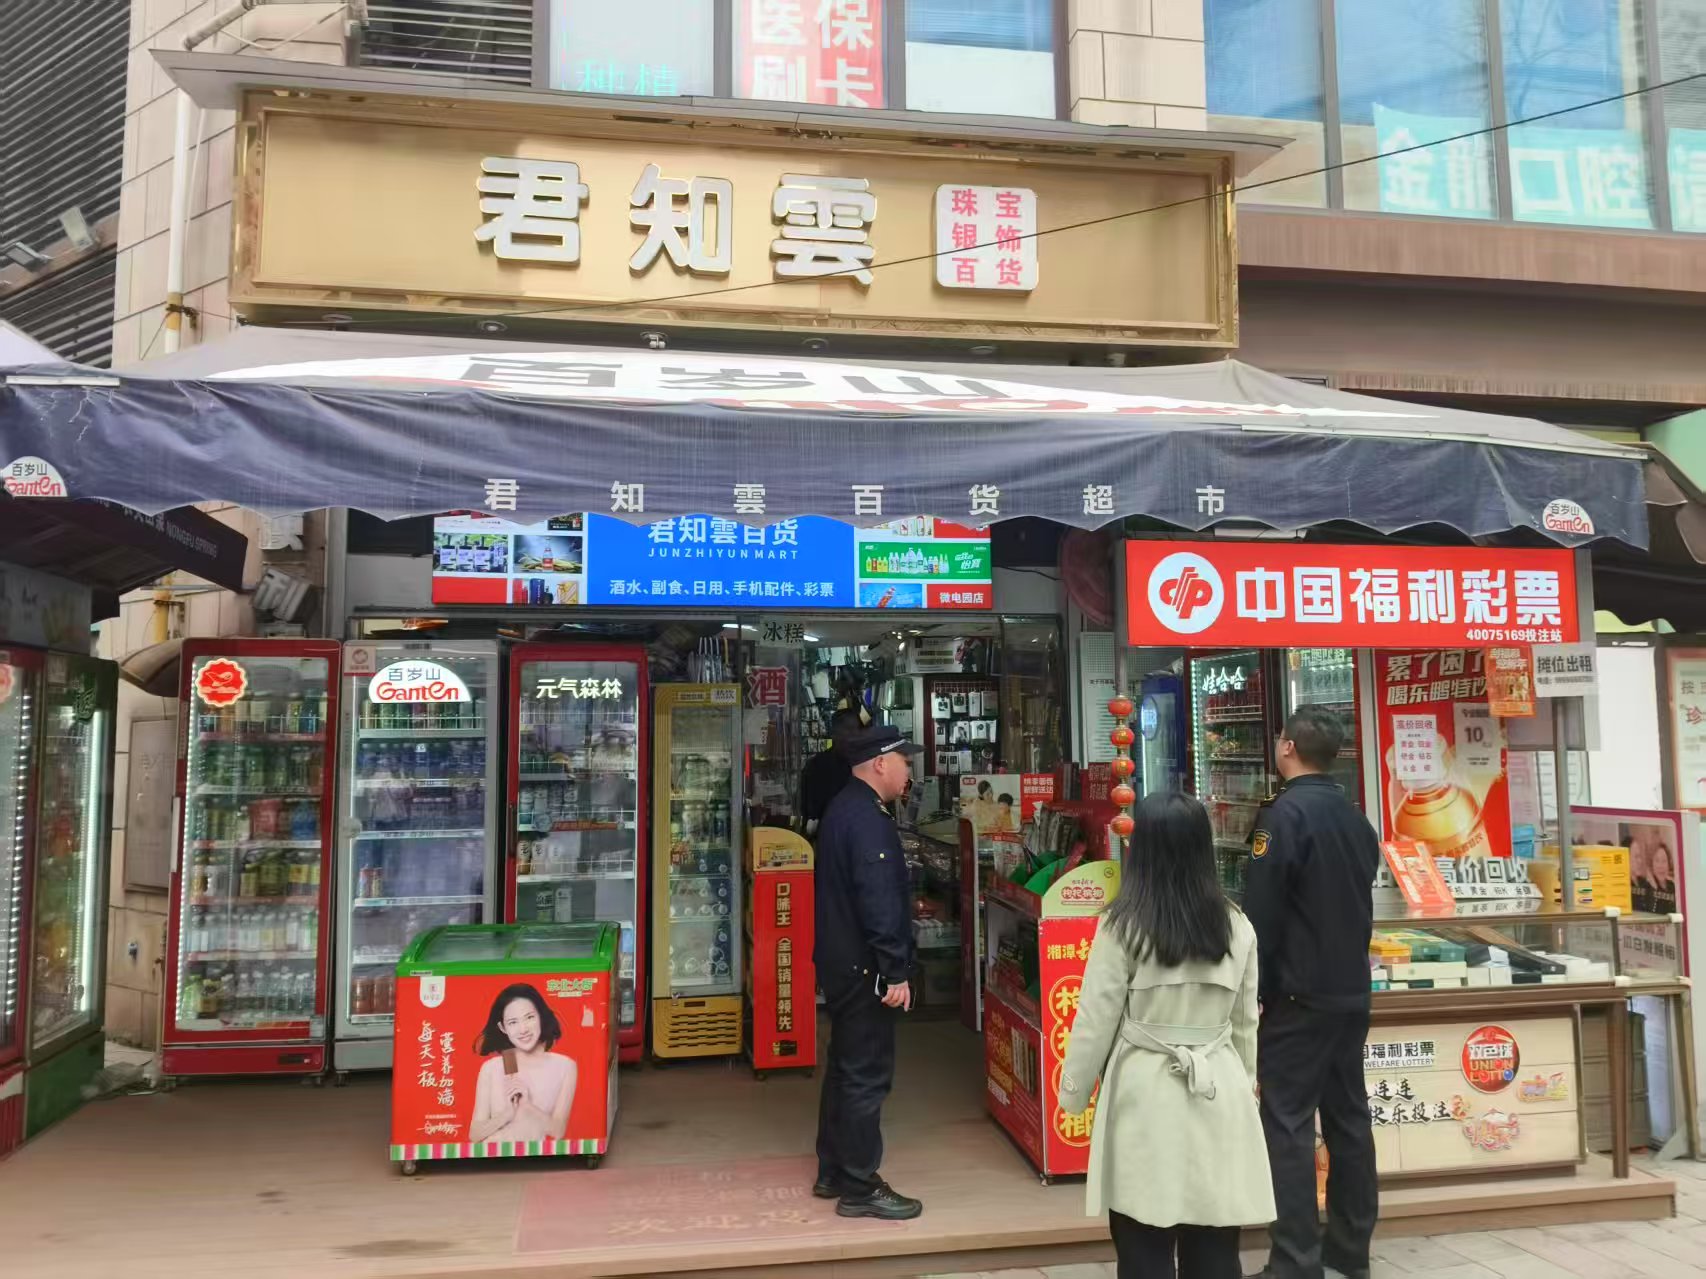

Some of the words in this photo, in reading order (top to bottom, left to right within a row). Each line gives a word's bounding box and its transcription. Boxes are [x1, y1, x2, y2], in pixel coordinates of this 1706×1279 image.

[951, 188, 1022, 219] 珠宝
[474, 156, 878, 285] 君知雲
[951, 223, 1022, 252] 银饰
[951, 257, 1022, 286] 百货
[460, 356, 1011, 399] 百岁山
[12, 463, 48, 476] 百岁山
[1550, 503, 1580, 516] 百岁山
[648, 516, 799, 546] 君知雲百货
[648, 548, 749, 559] JUNZHIYUN
[754, 550, 799, 560] MART
[609, 579, 835, 598] 酒水、副食、日用、手机配件、彩票
[939, 592, 984, 604] 微电园店
[1236, 567, 1562, 626] 中国福利彩票
[762, 621, 803, 643] 冰糕
[1465, 629, 1563, 642] 40075169投注站
[389, 668, 441, 681] 百岁山
[1385, 649, 1486, 682] 累了困了
[1537, 655, 1593, 673] 摊位出租
[376, 682, 459, 700] Ganten
[536, 678, 623, 698] 元气森林
[748, 666, 789, 708] 酒
[1202, 666, 1246, 695] 娃哈哈
[1436, 856, 1529, 884] 高价回收
[776, 882, 791, 926] 口味王
[777, 938, 793, 1031] 全国销量领先
[417, 1020, 438, 1088] 每天一板
[1470, 1059, 1514, 1071] UNION
[437, 1031, 456, 1107] 营养加满
[1469, 1069, 1514, 1083] LOTTO
